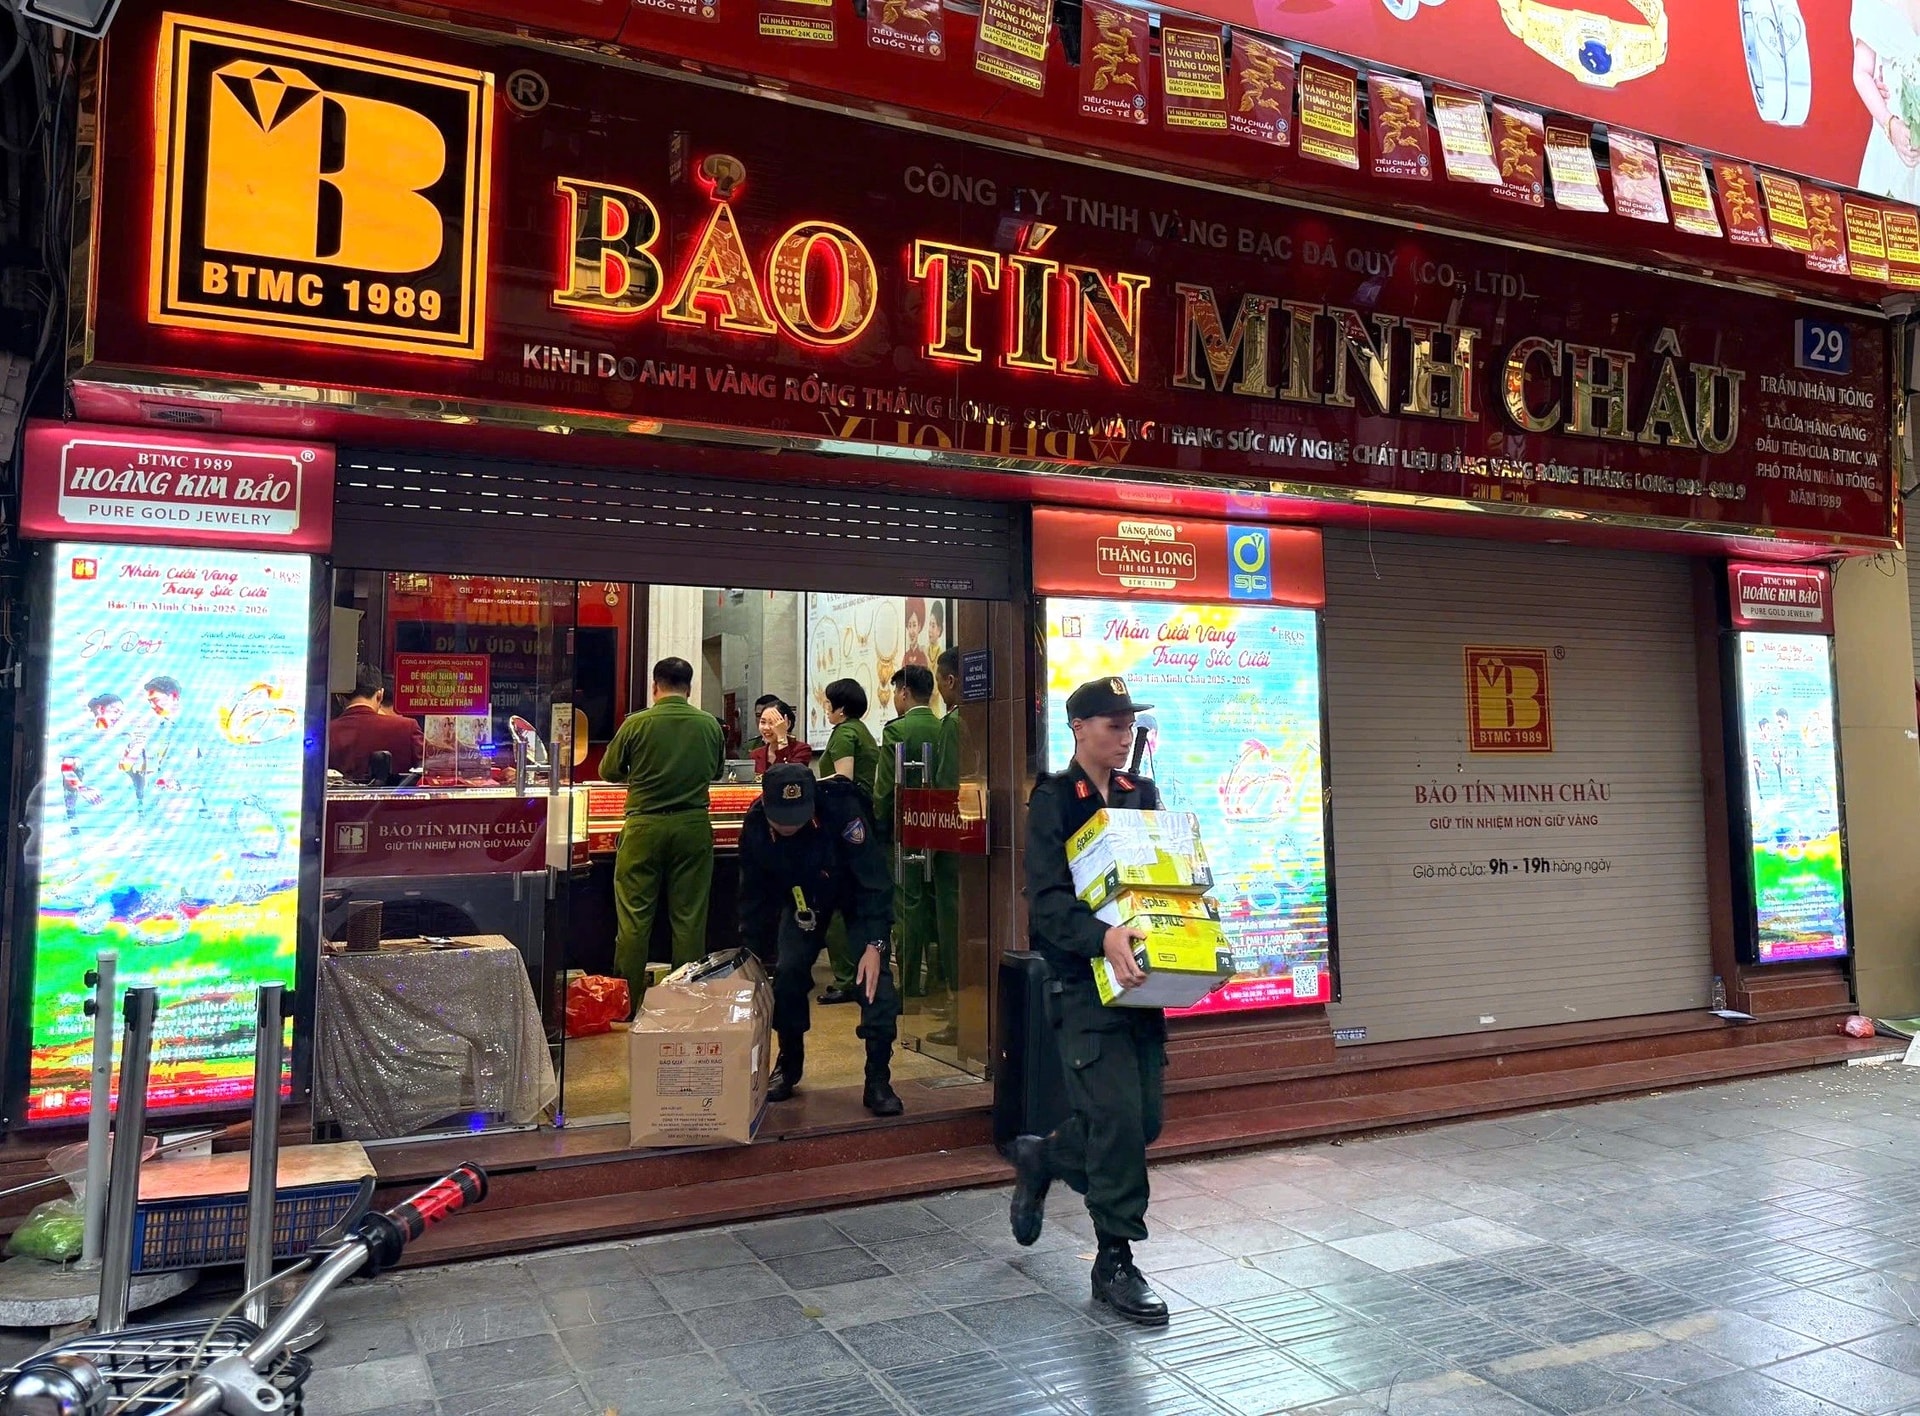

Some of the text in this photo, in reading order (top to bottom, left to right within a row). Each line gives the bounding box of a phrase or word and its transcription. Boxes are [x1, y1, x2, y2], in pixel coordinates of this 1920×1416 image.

[871, 27, 895, 38] TIÊU
[872, 36, 925, 53] QUỐC TẾ
[1167, 47, 1219, 62] VÀNG RỒNG
[1167, 59, 1220, 73] THĂNG LONG
[1083, 95, 1102, 105] TIÊU
[1082, 104, 1130, 118] QUỐC TẾ
[1375, 158, 1391, 166] TIÊU
[1375, 165, 1417, 175] QUỐC TẾ
[904, 163, 997, 206] CÔNG
[1061, 195, 1138, 234] TNHH
[1150, 210, 1228, 248] VÀNG
[1237, 228, 1293, 263] BẠC
[1302, 238, 1338, 269] ĐÁ
[1345, 248, 1398, 278] QUÝ
[201, 263, 441, 322] BTMC 1989
[551, 154, 1747, 454] BẢO TÍN MINH CHÂU
[1810, 327, 1843, 364] 29
[1760, 373, 1874, 409] TRẦN NHÂN TÔNG
[523, 343, 590, 376] KINH
[597, 352, 696, 390] DOANH
[705, 363, 777, 398] VÀNG
[784, 372, 855, 409] RỒNG
[862, 386, 943, 419] THĂNG
[1067, 408, 1094, 436] VÀ
[1100, 413, 1156, 442] VÀNG
[1161, 423, 1225, 450] TRANG
[1227, 427, 1265, 453] SỨC
[1268, 432, 1298, 457] MỸ
[1301, 438, 1350, 467] NGHỆ
[1353, 439, 1399, 468] CHẤT
[1401, 448, 1438, 475] LIỆU
[1536, 458, 1579, 485] RỒNG
[1583, 466, 1633, 491] THĂNG
[1635, 472, 1675, 495] LONG
[1766, 412, 1781, 430] LÀ
[1806, 418, 1837, 436] HÀNG
[1839, 422, 1867, 442] VÀNG
[1757, 434, 1779, 454] ĐẦU
[1832, 447, 1862, 464] BTMC
[138, 452, 233, 472] BTMC 1989
[70, 463, 291, 503] HOÀNG KIM BẢO
[1756, 461, 1781, 479] PHỐ
[1782, 462, 1812, 484] TRẦN
[1845, 472, 1876, 490] TÔNG
[1817, 494, 1842, 509] 1989
[89, 504, 272, 527] PURE GOLD JEWELRY
[1121, 524, 1172, 537] VÀNG RỒNG
[1099, 545, 1193, 566] THĂNG LONG
[166, 567, 197, 580] Cưới
[1119, 564, 1134, 573] FINE
[1137, 565, 1154, 574] GOLD
[162, 581, 204, 599] Trang
[209, 582, 233, 598] Sức
[1742, 583, 1818, 604] HOÀNG KIM BẢO
[1750, 607, 1814, 618] PURE GOLD JEWELRY
[1103, 617, 1305, 649] Nhẫn Cưới Vàng EROS
[1152, 645, 1272, 672] Trang Sức Cưới
[1160, 673, 1183, 684] Minh
[1207, 675, 1225, 685] 2025
[1232, 675, 1251, 685] 2026
[1479, 730, 1543, 743] BTMC 1989
[1415, 778, 1611, 804] BẢO TÍN MINH CHÂU
[379, 819, 539, 837] BẢO TÍN MINH CHÂU
[920, 809, 937, 828] QUÝ
[939, 809, 969, 831] KHÁCH
[1429, 816, 1452, 830] GIỮ
[1477, 816, 1513, 831] NHIỆM
[1516, 815, 1542, 828] HƠN
[1544, 814, 1566, 828] GIỮ
[1569, 812, 1599, 827] VÀNG
[385, 837, 531, 852] GIỮ TÍN NHIỆM HƠN GIỮ VÀNG
[1413, 863, 1435, 879] Giờ
[1437, 862, 1456, 877] mở
[1459, 861, 1486, 877] cửa:
[1489, 858, 1509, 876] 9h
[1523, 857, 1550, 874] 19h
[1553, 859, 1582, 876] hàng
[1584, 858, 1612, 875] ngày
[1220, 956, 1230, 965] 70
